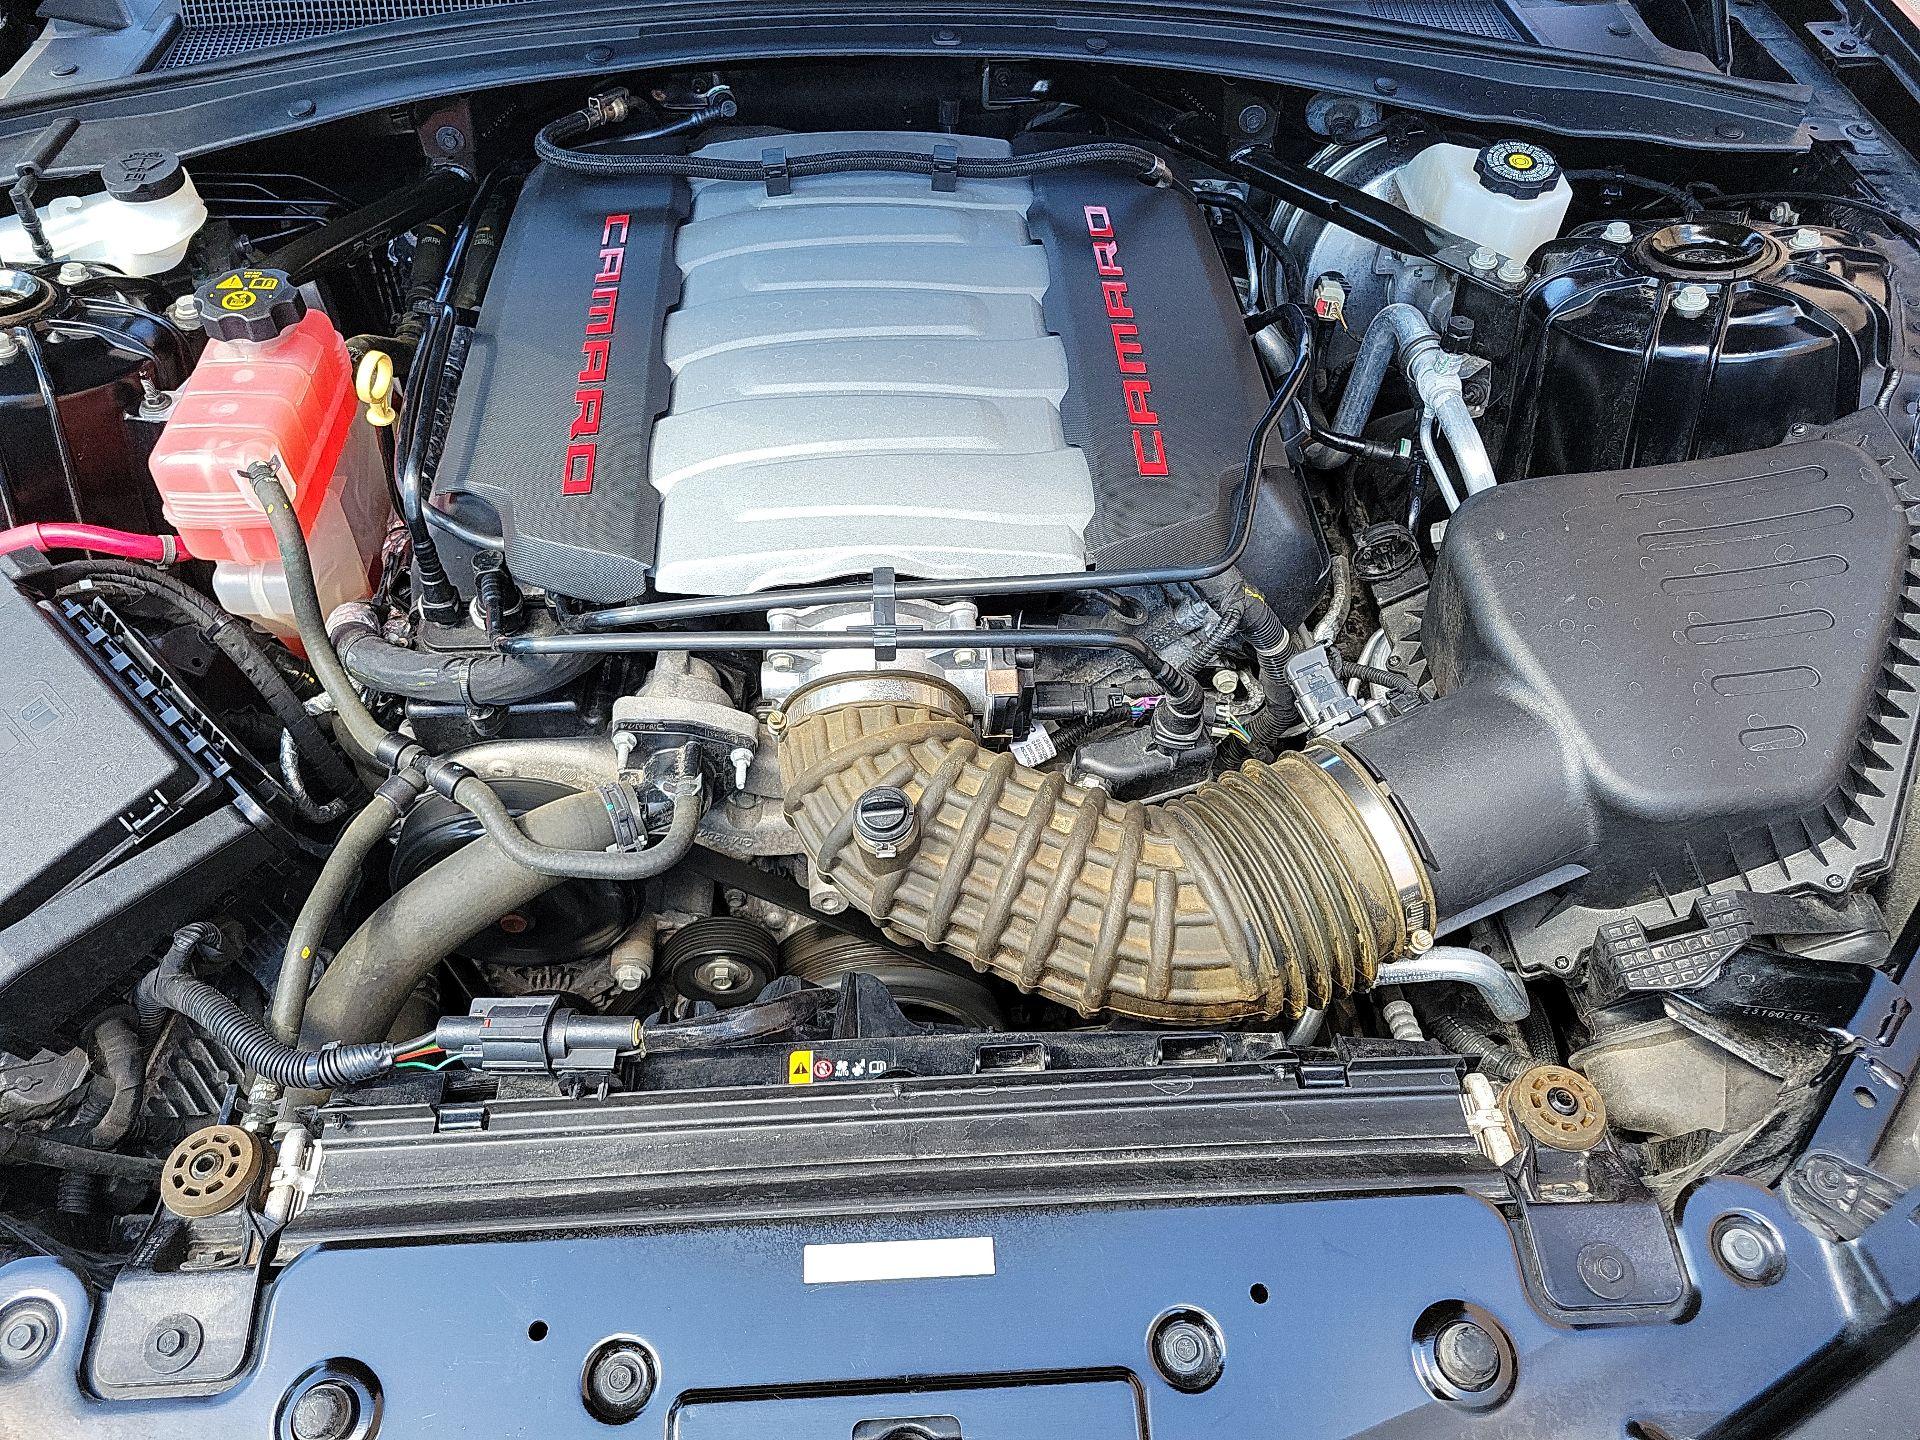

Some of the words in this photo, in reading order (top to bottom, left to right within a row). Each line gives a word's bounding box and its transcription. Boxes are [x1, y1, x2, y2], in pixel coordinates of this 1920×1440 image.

[562, 214, 630, 495] CAMARO
[1084, 205, 1169, 476] CAMARO
[834, 1069, 850, 1077] AUTO
